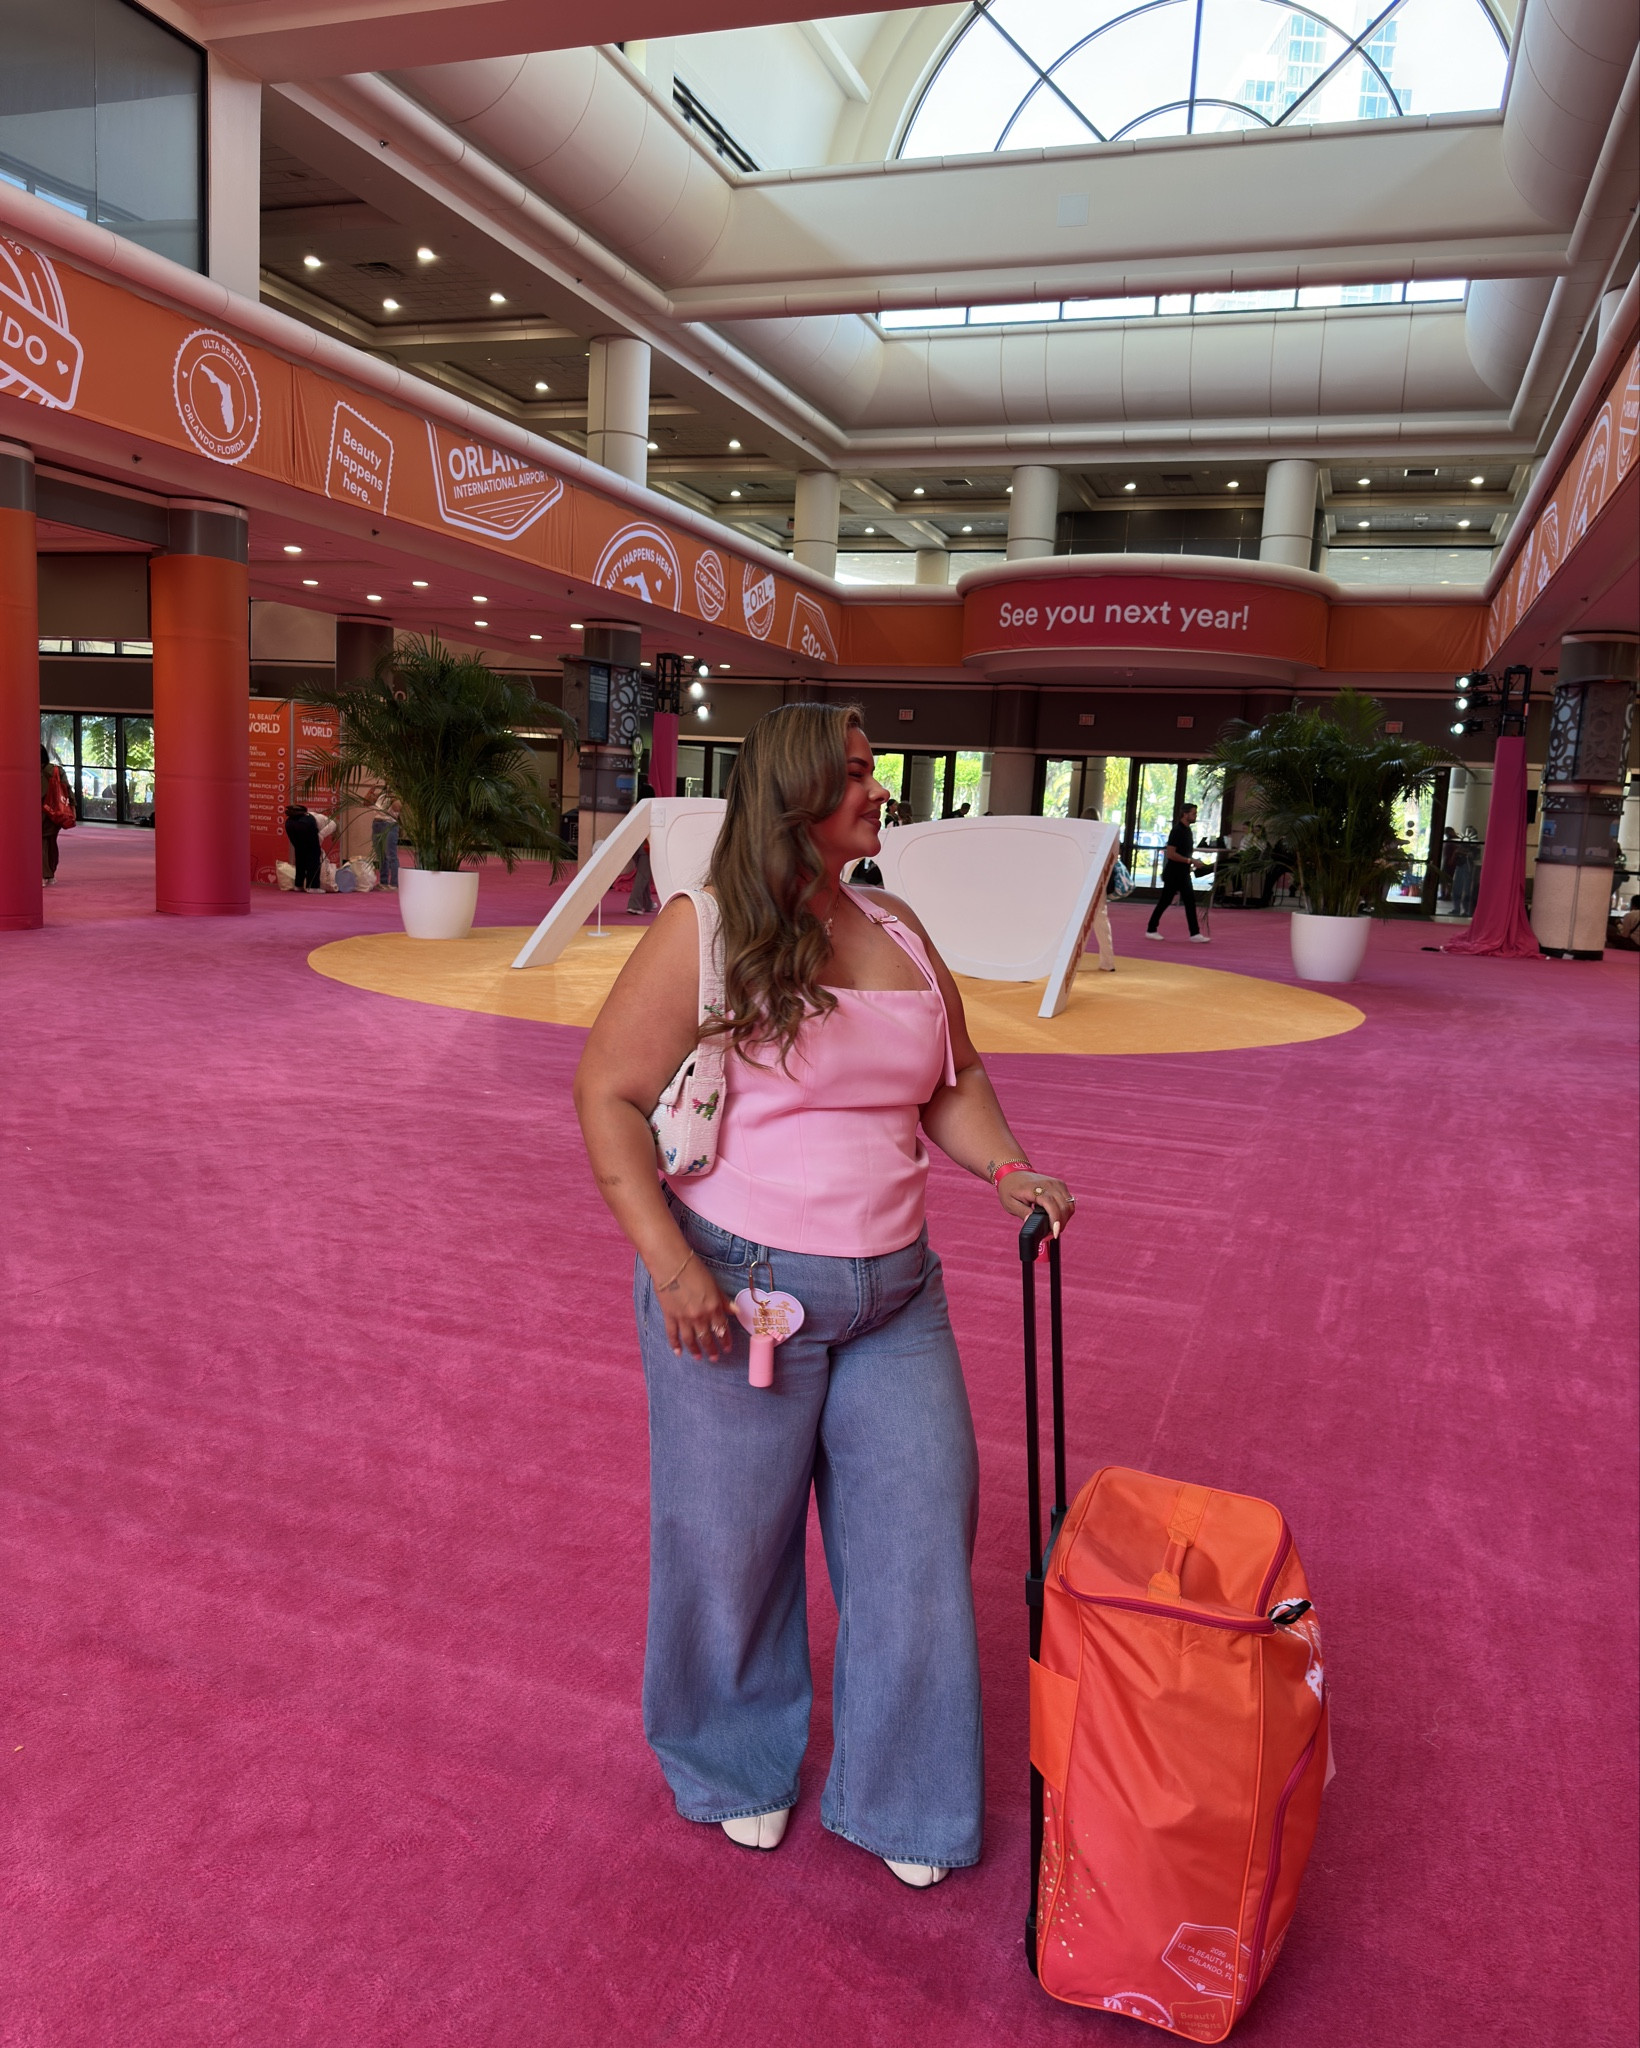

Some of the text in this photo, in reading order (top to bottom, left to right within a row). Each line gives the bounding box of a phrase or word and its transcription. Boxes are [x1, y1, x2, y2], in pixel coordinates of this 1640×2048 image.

[0, 310, 48, 366] DO
[202, 339, 247, 377] ULTA BEAUTY
[184, 403, 246, 455] ORLANDO, FLORIDA
[342, 428, 382, 469] Beauty
[336, 445, 384, 492] happens
[342, 473, 371, 505] here.
[453, 477, 518, 499] INTERNATIONAL
[605, 559, 623, 590] AUTY
[622, 547, 655, 569] HAPPENS
[655, 552, 673, 580] HERE
[749, 582, 770, 611] ORL
[999, 601, 1249, 632] See you next year!
[257, 713, 281, 721] BEAUTY
[302, 725, 333, 738] WORLD
[1177, 1942, 1195, 1954] ULTA
[1196, 1949, 1225, 1966] BEAUTY
[1210, 1946, 1227, 1958] 2026
[1187, 1955, 1233, 1981] ORLANDO, FL
